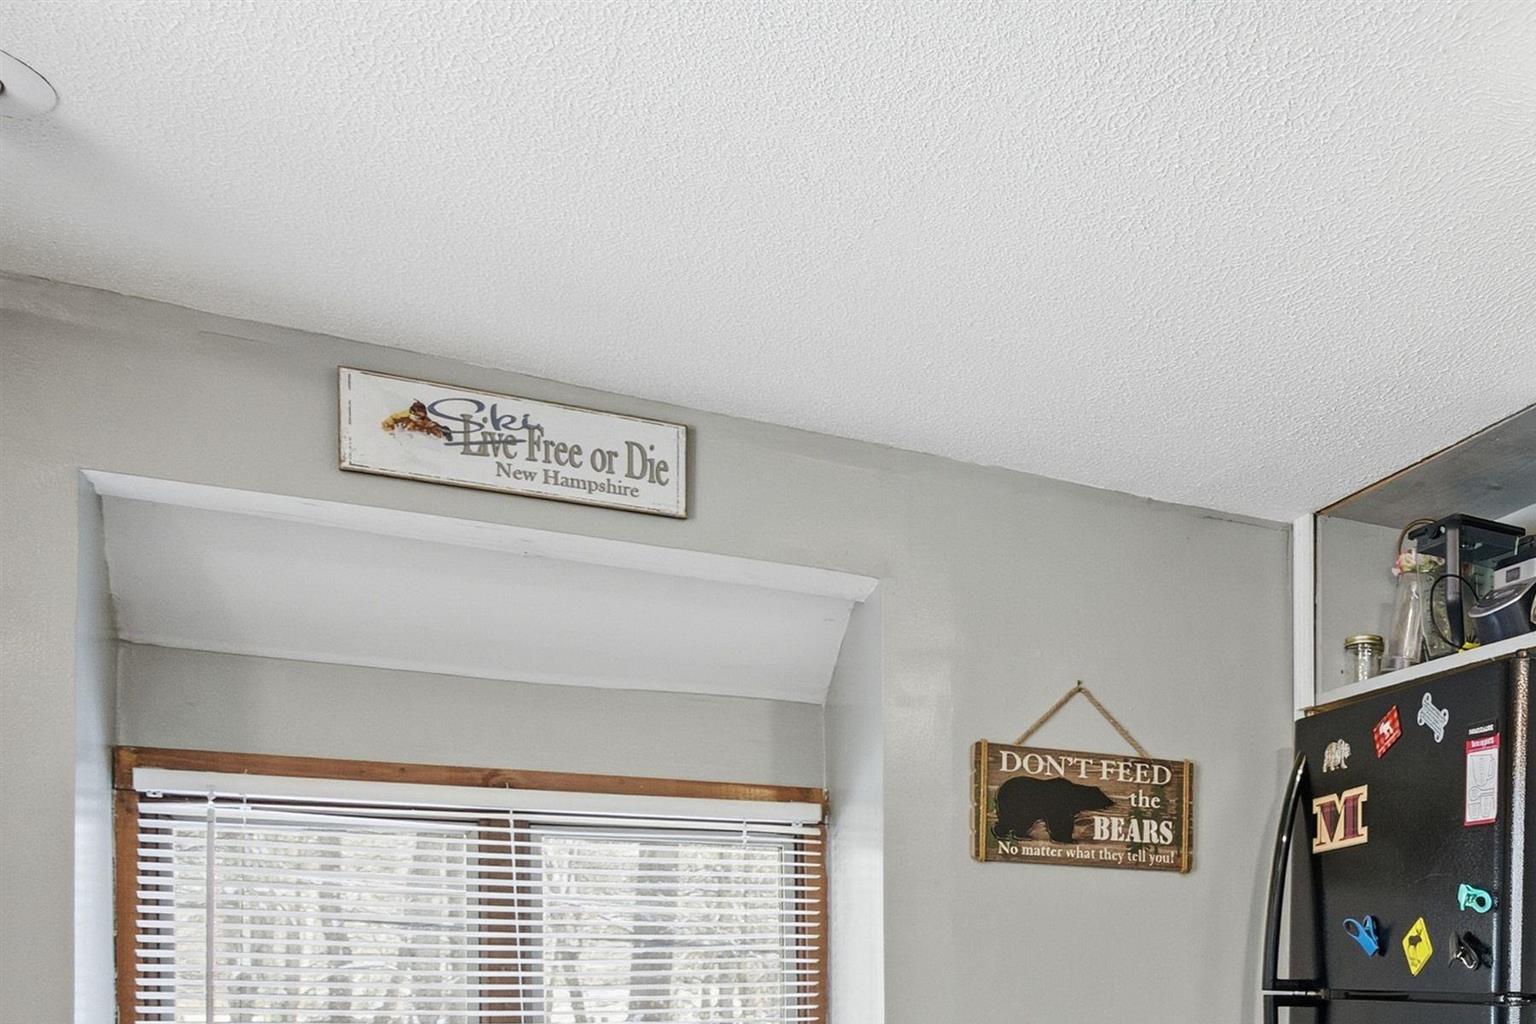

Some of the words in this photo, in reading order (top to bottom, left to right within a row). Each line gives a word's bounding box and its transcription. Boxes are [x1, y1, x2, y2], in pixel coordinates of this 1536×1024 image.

[427, 398, 541, 435] Ski
[460, 413, 518, 460] Live
[525, 425, 582, 467] Free
[590, 448, 618, 474] or
[625, 440, 670, 486] Die
[496, 461, 538, 483] New
[542, 470, 640, 499] Hampshire
[999, 750, 1095, 779] DON'T
[1100, 760, 1173, 786] FEED
[1130, 790, 1162, 809] the
[1092, 815, 1174, 845] BEARS
[1312, 784, 1368, 854] M
[998, 841, 1019, 855] No
[1021, 844, 1063, 858] matter
[1065, 845, 1096, 860] what
[1099, 847, 1125, 864] they
[1127, 849, 1147, 863] tell
[1149, 850, 1176, 866] you!
